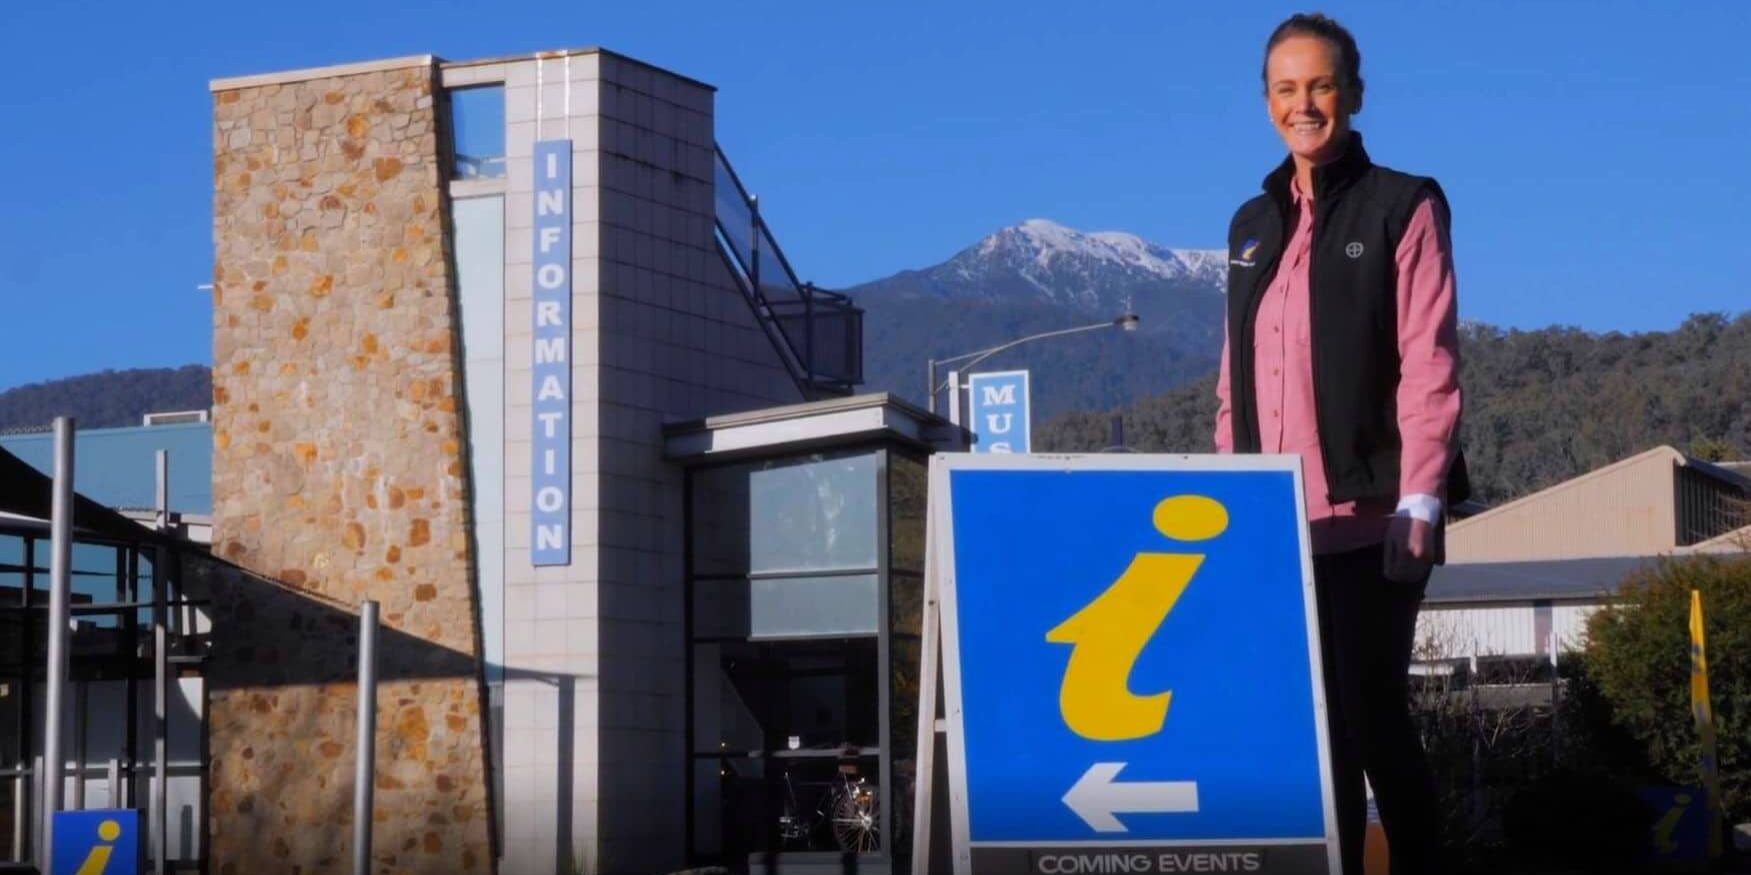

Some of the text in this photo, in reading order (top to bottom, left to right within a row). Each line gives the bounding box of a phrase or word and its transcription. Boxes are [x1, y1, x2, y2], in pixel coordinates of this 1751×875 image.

[535, 153, 565, 550] INFORMATION
[1046, 495, 1229, 741] i
[1038, 853, 1260, 873] COMING EVENTS
